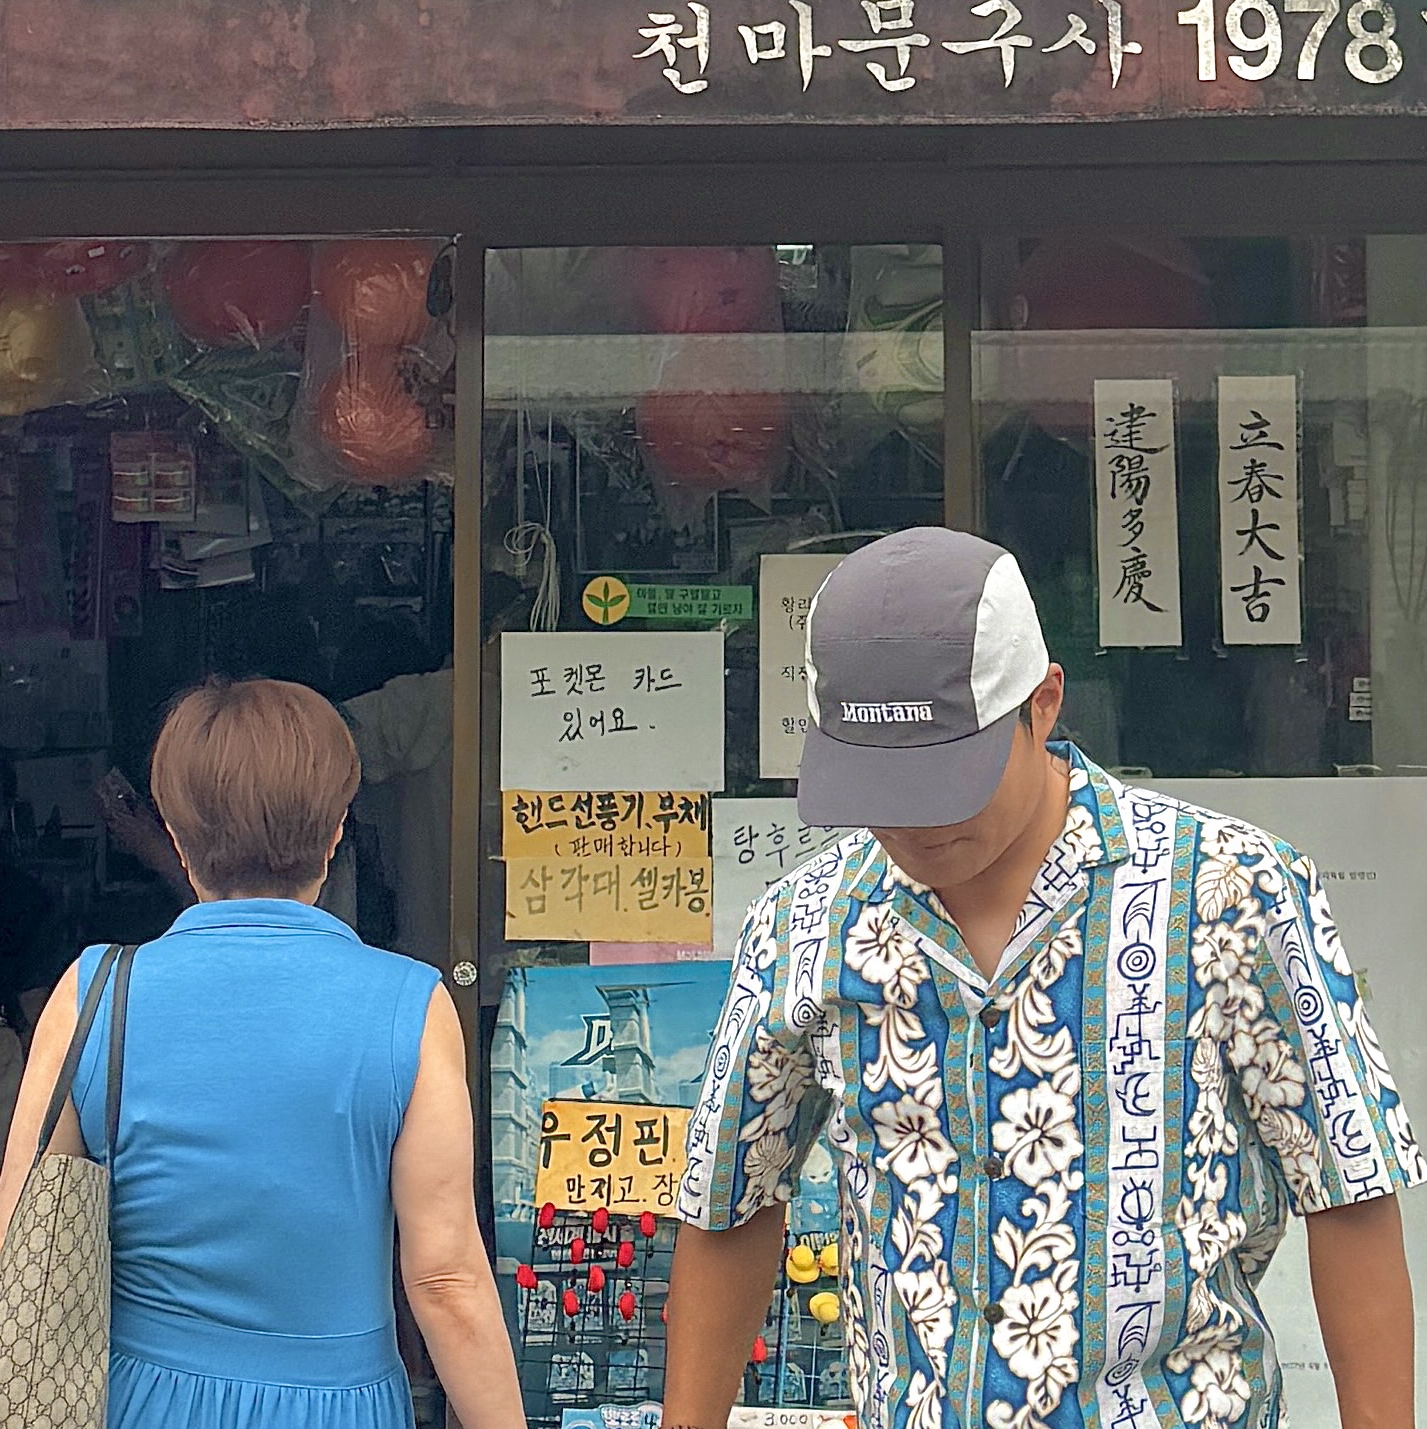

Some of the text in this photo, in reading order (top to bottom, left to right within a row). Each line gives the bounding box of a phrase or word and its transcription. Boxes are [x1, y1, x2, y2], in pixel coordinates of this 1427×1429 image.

[1228, 409, 1286, 624] 立春大吉
[529, 663, 683, 698] 포켓몬 카드
[558, 707, 657, 743] 있어요.
[840, 701, 934, 723] Montana
